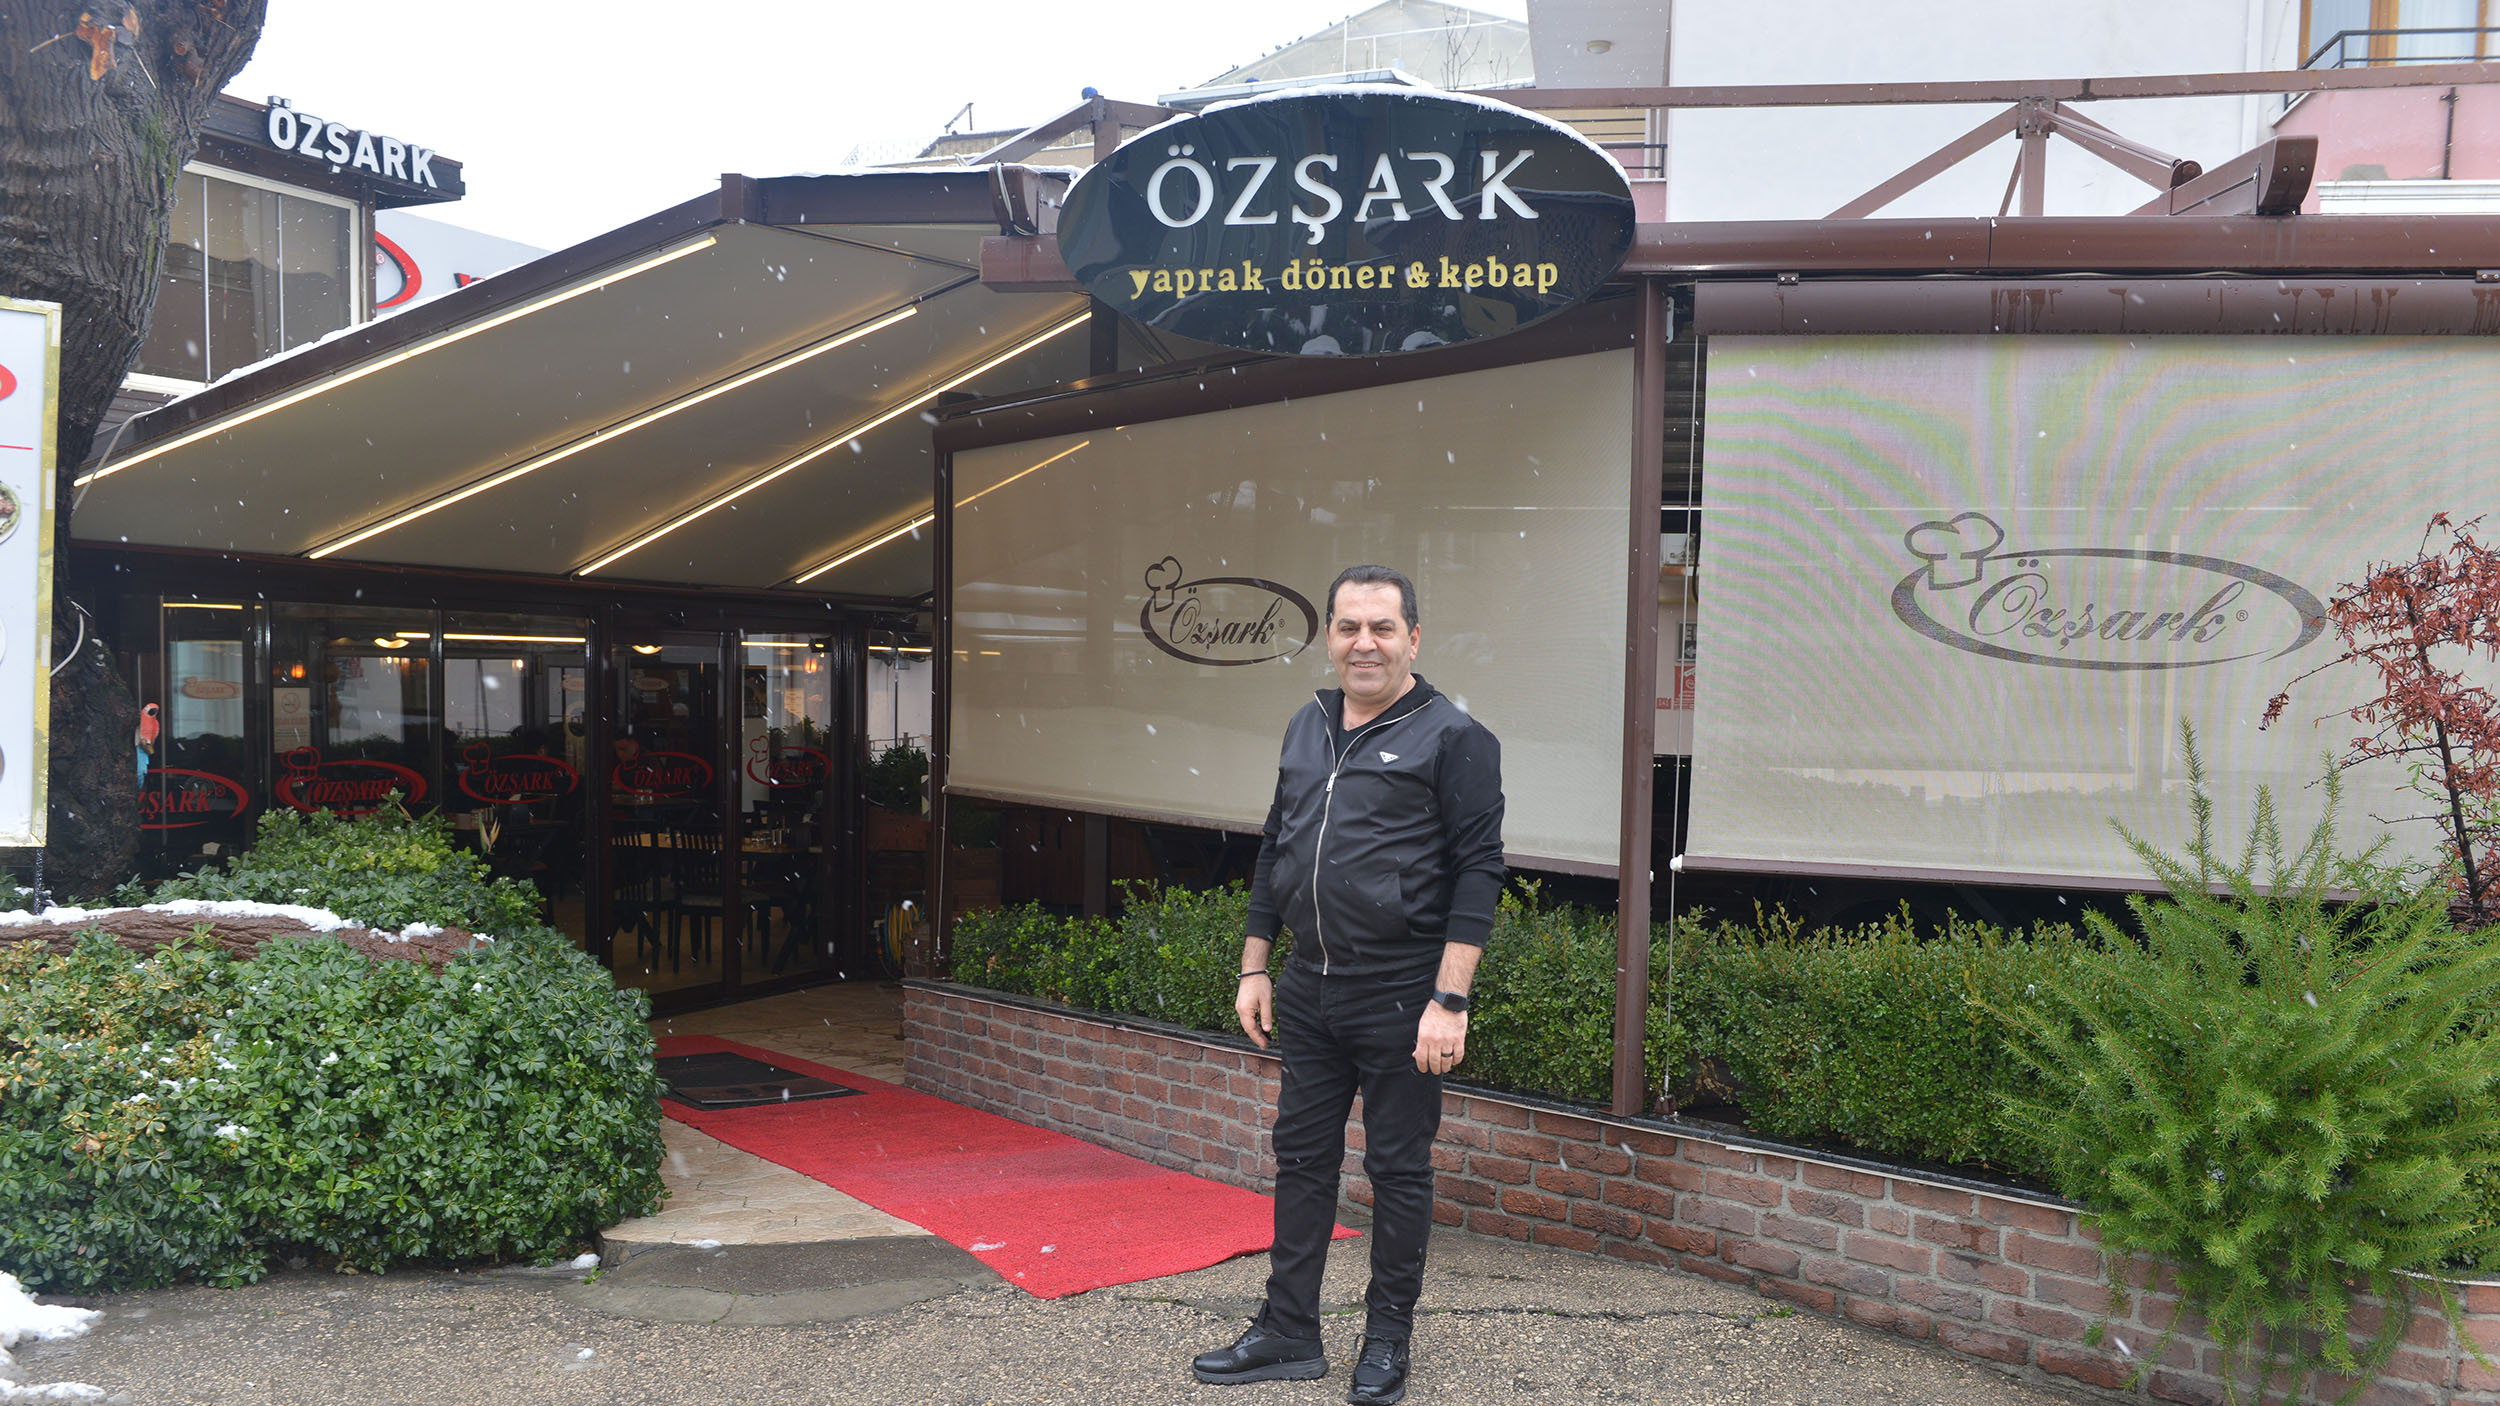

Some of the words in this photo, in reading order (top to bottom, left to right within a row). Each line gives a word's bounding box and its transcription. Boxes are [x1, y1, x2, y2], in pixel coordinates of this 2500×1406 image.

[267, 95, 438, 189] ÖZŞARK
[1146, 143, 1540, 246] ÖZŞARK
[1128, 259, 1265, 299] yaprak
[1281, 257, 1396, 292] döner
[1406, 261, 1430, 289] &
[1438, 255, 1559, 294] kebap
[1168, 586, 1284, 653] Özşark
[1968, 558, 2246, 651] Özşark
